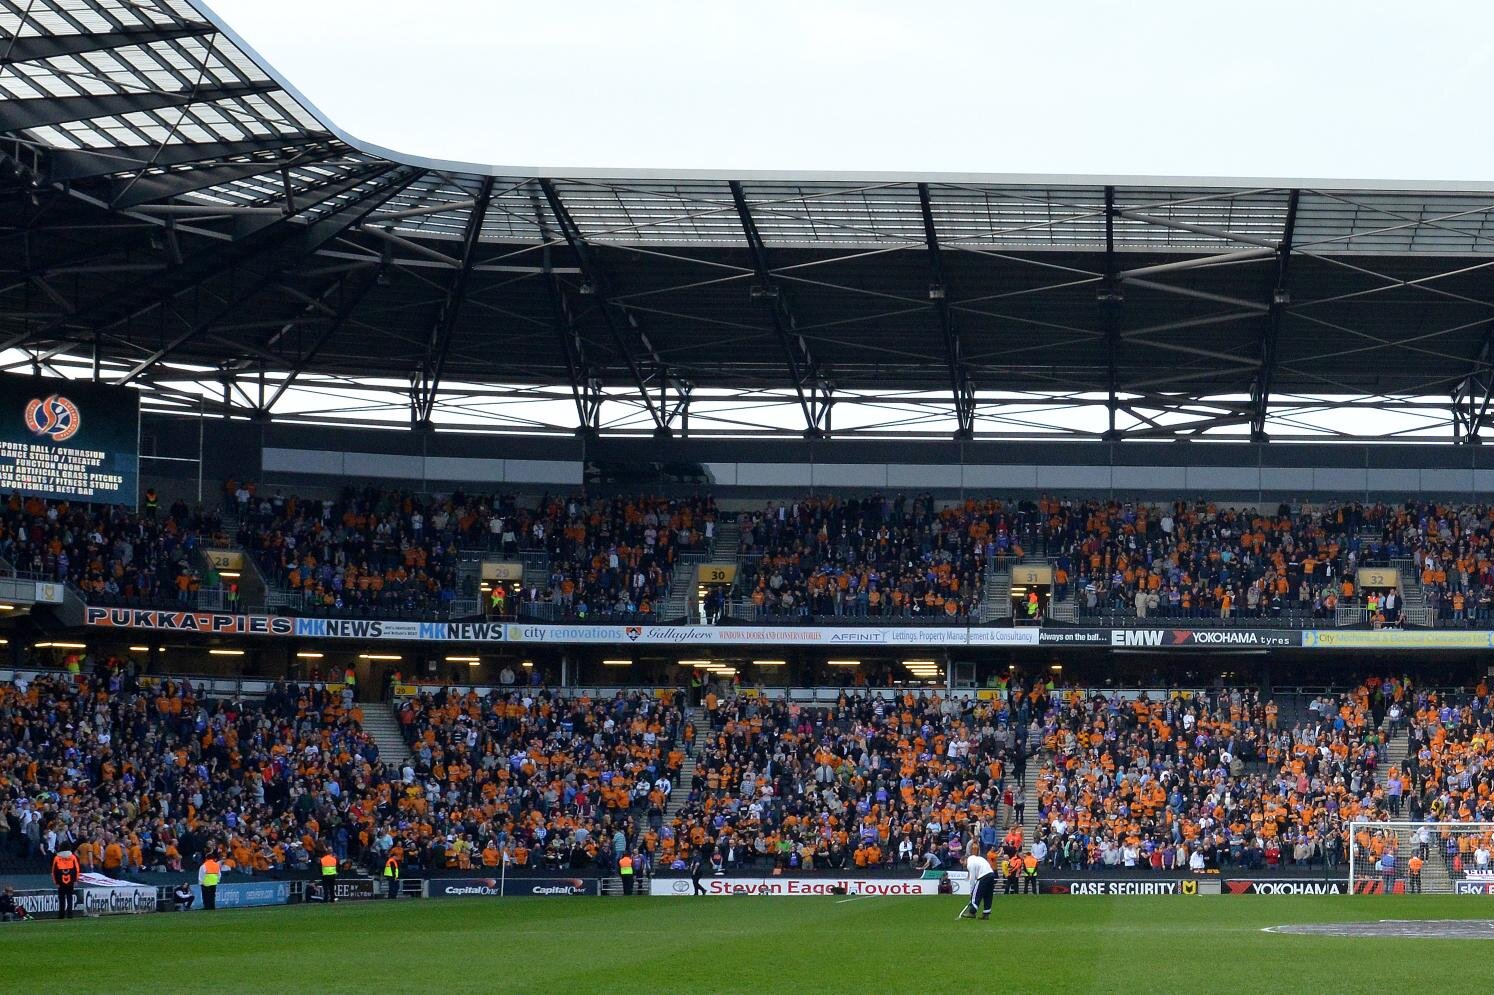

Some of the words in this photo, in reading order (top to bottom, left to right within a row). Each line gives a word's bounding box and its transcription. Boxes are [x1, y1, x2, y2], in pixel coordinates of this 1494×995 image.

[1, 449, 28, 459] DANCE
[29, 452, 58, 462] STUDIO
[68, 456, 101, 466] THEATRE
[30, 444, 49, 453] HALL
[57, 447, 105, 459] GYMNASIUM
[16, 458, 56, 469] FUNCTION
[58, 462, 86, 472] ROOMS
[16, 465, 60, 477] ARTIFICIAL
[62, 470, 88, 479] GRASS
[90, 473, 123, 483] PITCHES
[15, 473, 48, 483] COURTS
[56, 477, 88, 488] FITNESS
[89, 480, 119, 491] STUDIO
[56, 485, 75, 494] REST
[77, 487, 94, 496] BAR
[215, 556, 229, 567] 28
[711, 570, 725, 580] 30
[1026, 572, 1038, 583] 31
[1370, 575, 1384, 585] 32
[524, 627, 546, 641] city
[549, 627, 622, 641] renovations
[647, 628, 713, 642] Gallaghers
[919, 631, 945, 643] Property
[996, 631, 1033, 643] Consultancy
[1039, 632, 1064, 642] Always
[1075, 632, 1085, 641] the
[1111, 630, 1165, 646] EMW
[1192, 631, 1258, 644] YOKOHAMA
[1260, 635, 1290, 645] tyres
[1319, 633, 1335, 645] City
[710, 880, 782, 894] Steven
[853, 880, 922, 895] Toyota
[1070, 882, 1105, 895] CASE
[1109, 882, 1176, 895] SECURITY
[1252, 883, 1340, 895] YOKOHAMA
[1460, 882, 1484, 895] sky
[85, 890, 110, 913] Citizen
[110, 889, 133, 911] Citizen
[133, 888, 156, 911] Citizen
